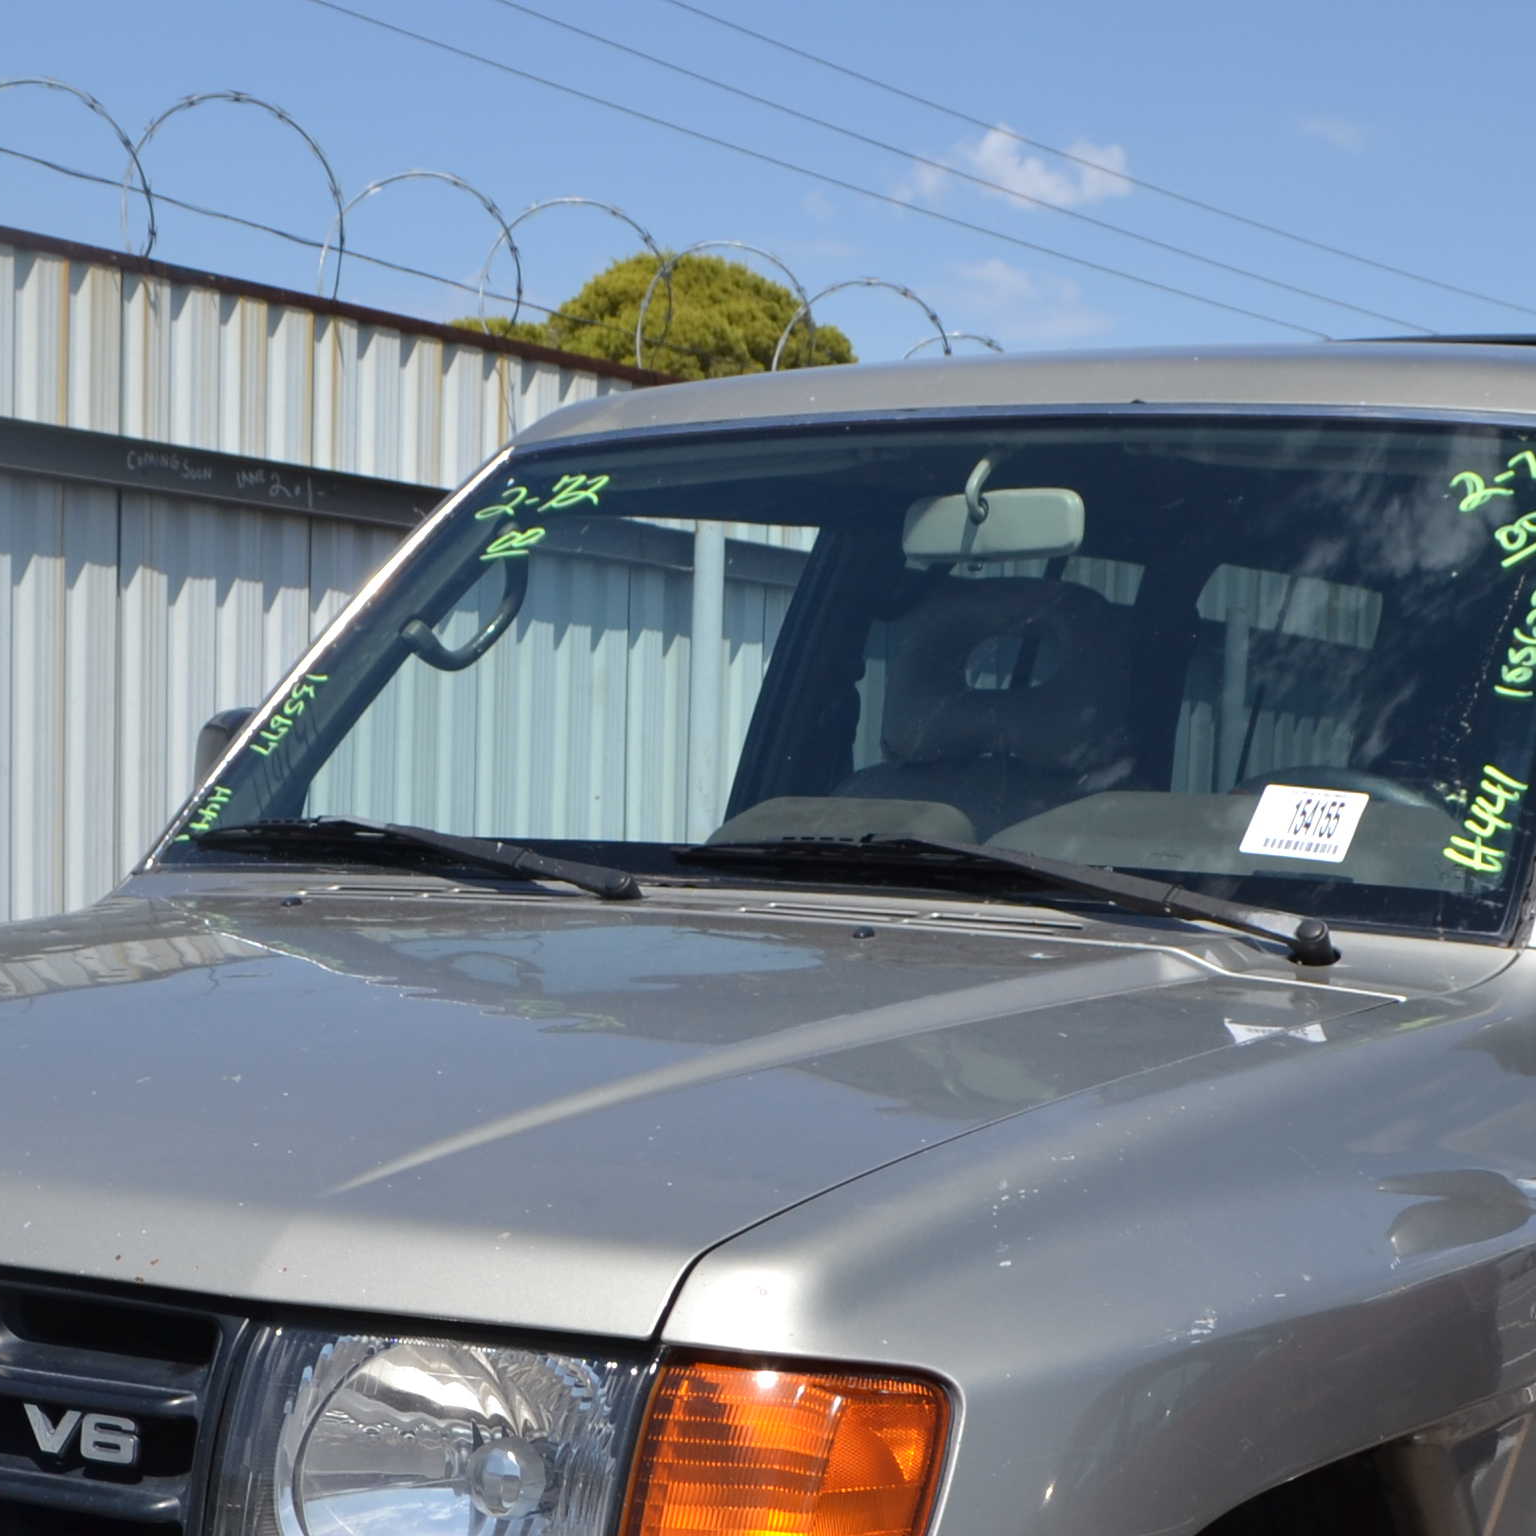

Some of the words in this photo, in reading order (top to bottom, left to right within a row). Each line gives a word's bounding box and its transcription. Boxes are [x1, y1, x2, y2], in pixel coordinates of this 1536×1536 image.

[474, 474, 611, 520] 2-72
[1287, 798, 1346, 839] 154155
[1442, 763, 1530, 873] H441
[23, 1402, 140, 1465] V6
